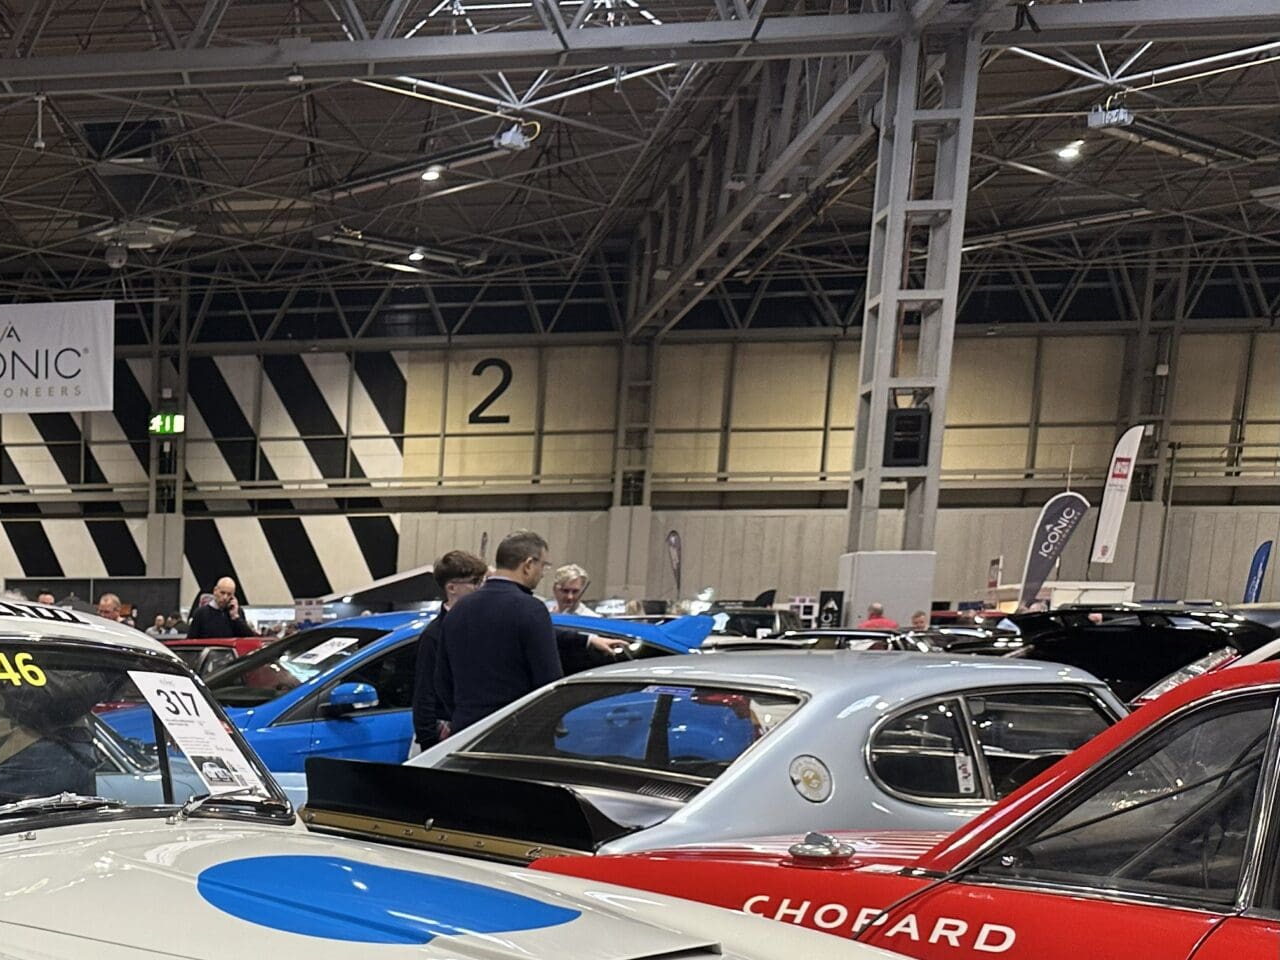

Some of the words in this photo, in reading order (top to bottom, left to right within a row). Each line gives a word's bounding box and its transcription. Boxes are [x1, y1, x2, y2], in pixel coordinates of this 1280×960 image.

[468, 357, 513, 424] 2
[1038, 507, 1075, 557] ICONIC
[156, 689, 200, 717] 317
[742, 895, 1017, 953] CHOPARD
